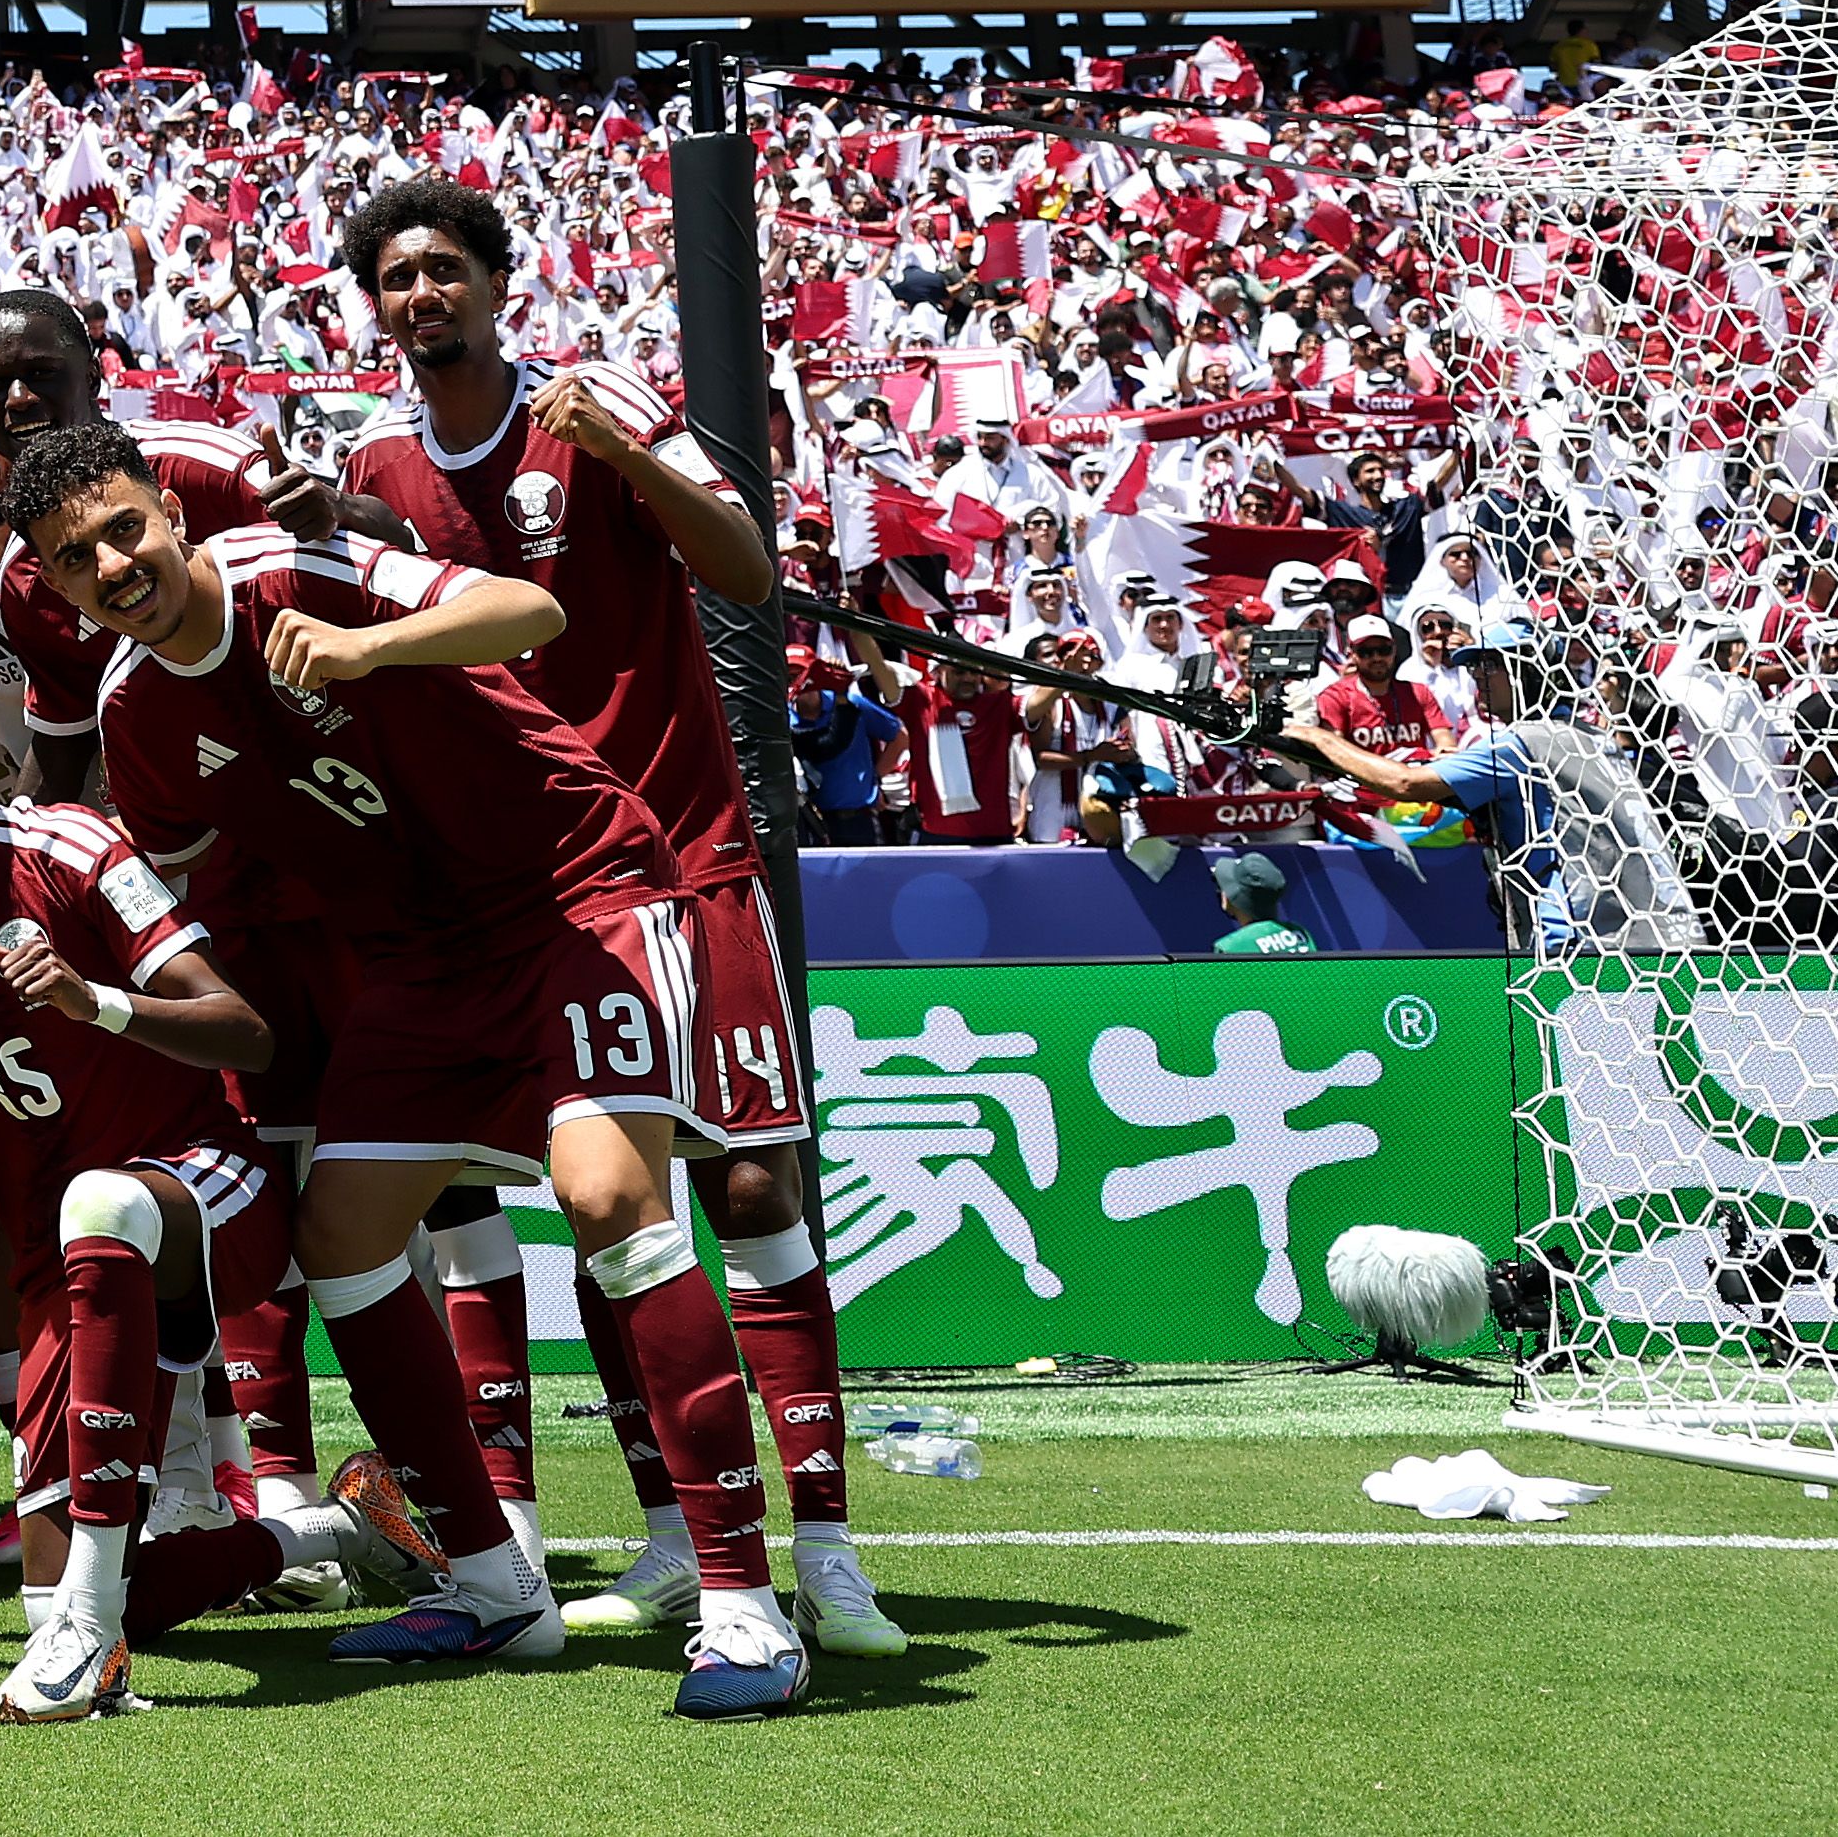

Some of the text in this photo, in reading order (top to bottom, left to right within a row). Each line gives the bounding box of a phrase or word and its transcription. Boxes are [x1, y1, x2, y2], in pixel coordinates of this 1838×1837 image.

[831, 359, 905, 378] QATAR
[288, 375, 355, 391] QATAR
[1353, 393, 1415, 412] Qatar
[1049, 415, 1122, 438] QATAR
[1203, 401, 1276, 430] QATAR
[524, 517, 554, 531] QFA
[302, 693, 323, 712] QFA
[1354, 721, 1422, 747] QATAR
[289, 757, 388, 827] 13
[133, 892, 160, 914] PEACE
[564, 992, 654, 1080] 13
[714, 1025, 787, 1114] 14
[815, 1004, 1383, 1325] 蒙牛
[478, 1379, 525, 1400] QFA
[606, 1397, 646, 1419] QFA
[784, 1403, 834, 1424] QFA
[80, 1410, 136, 1431] QFA
